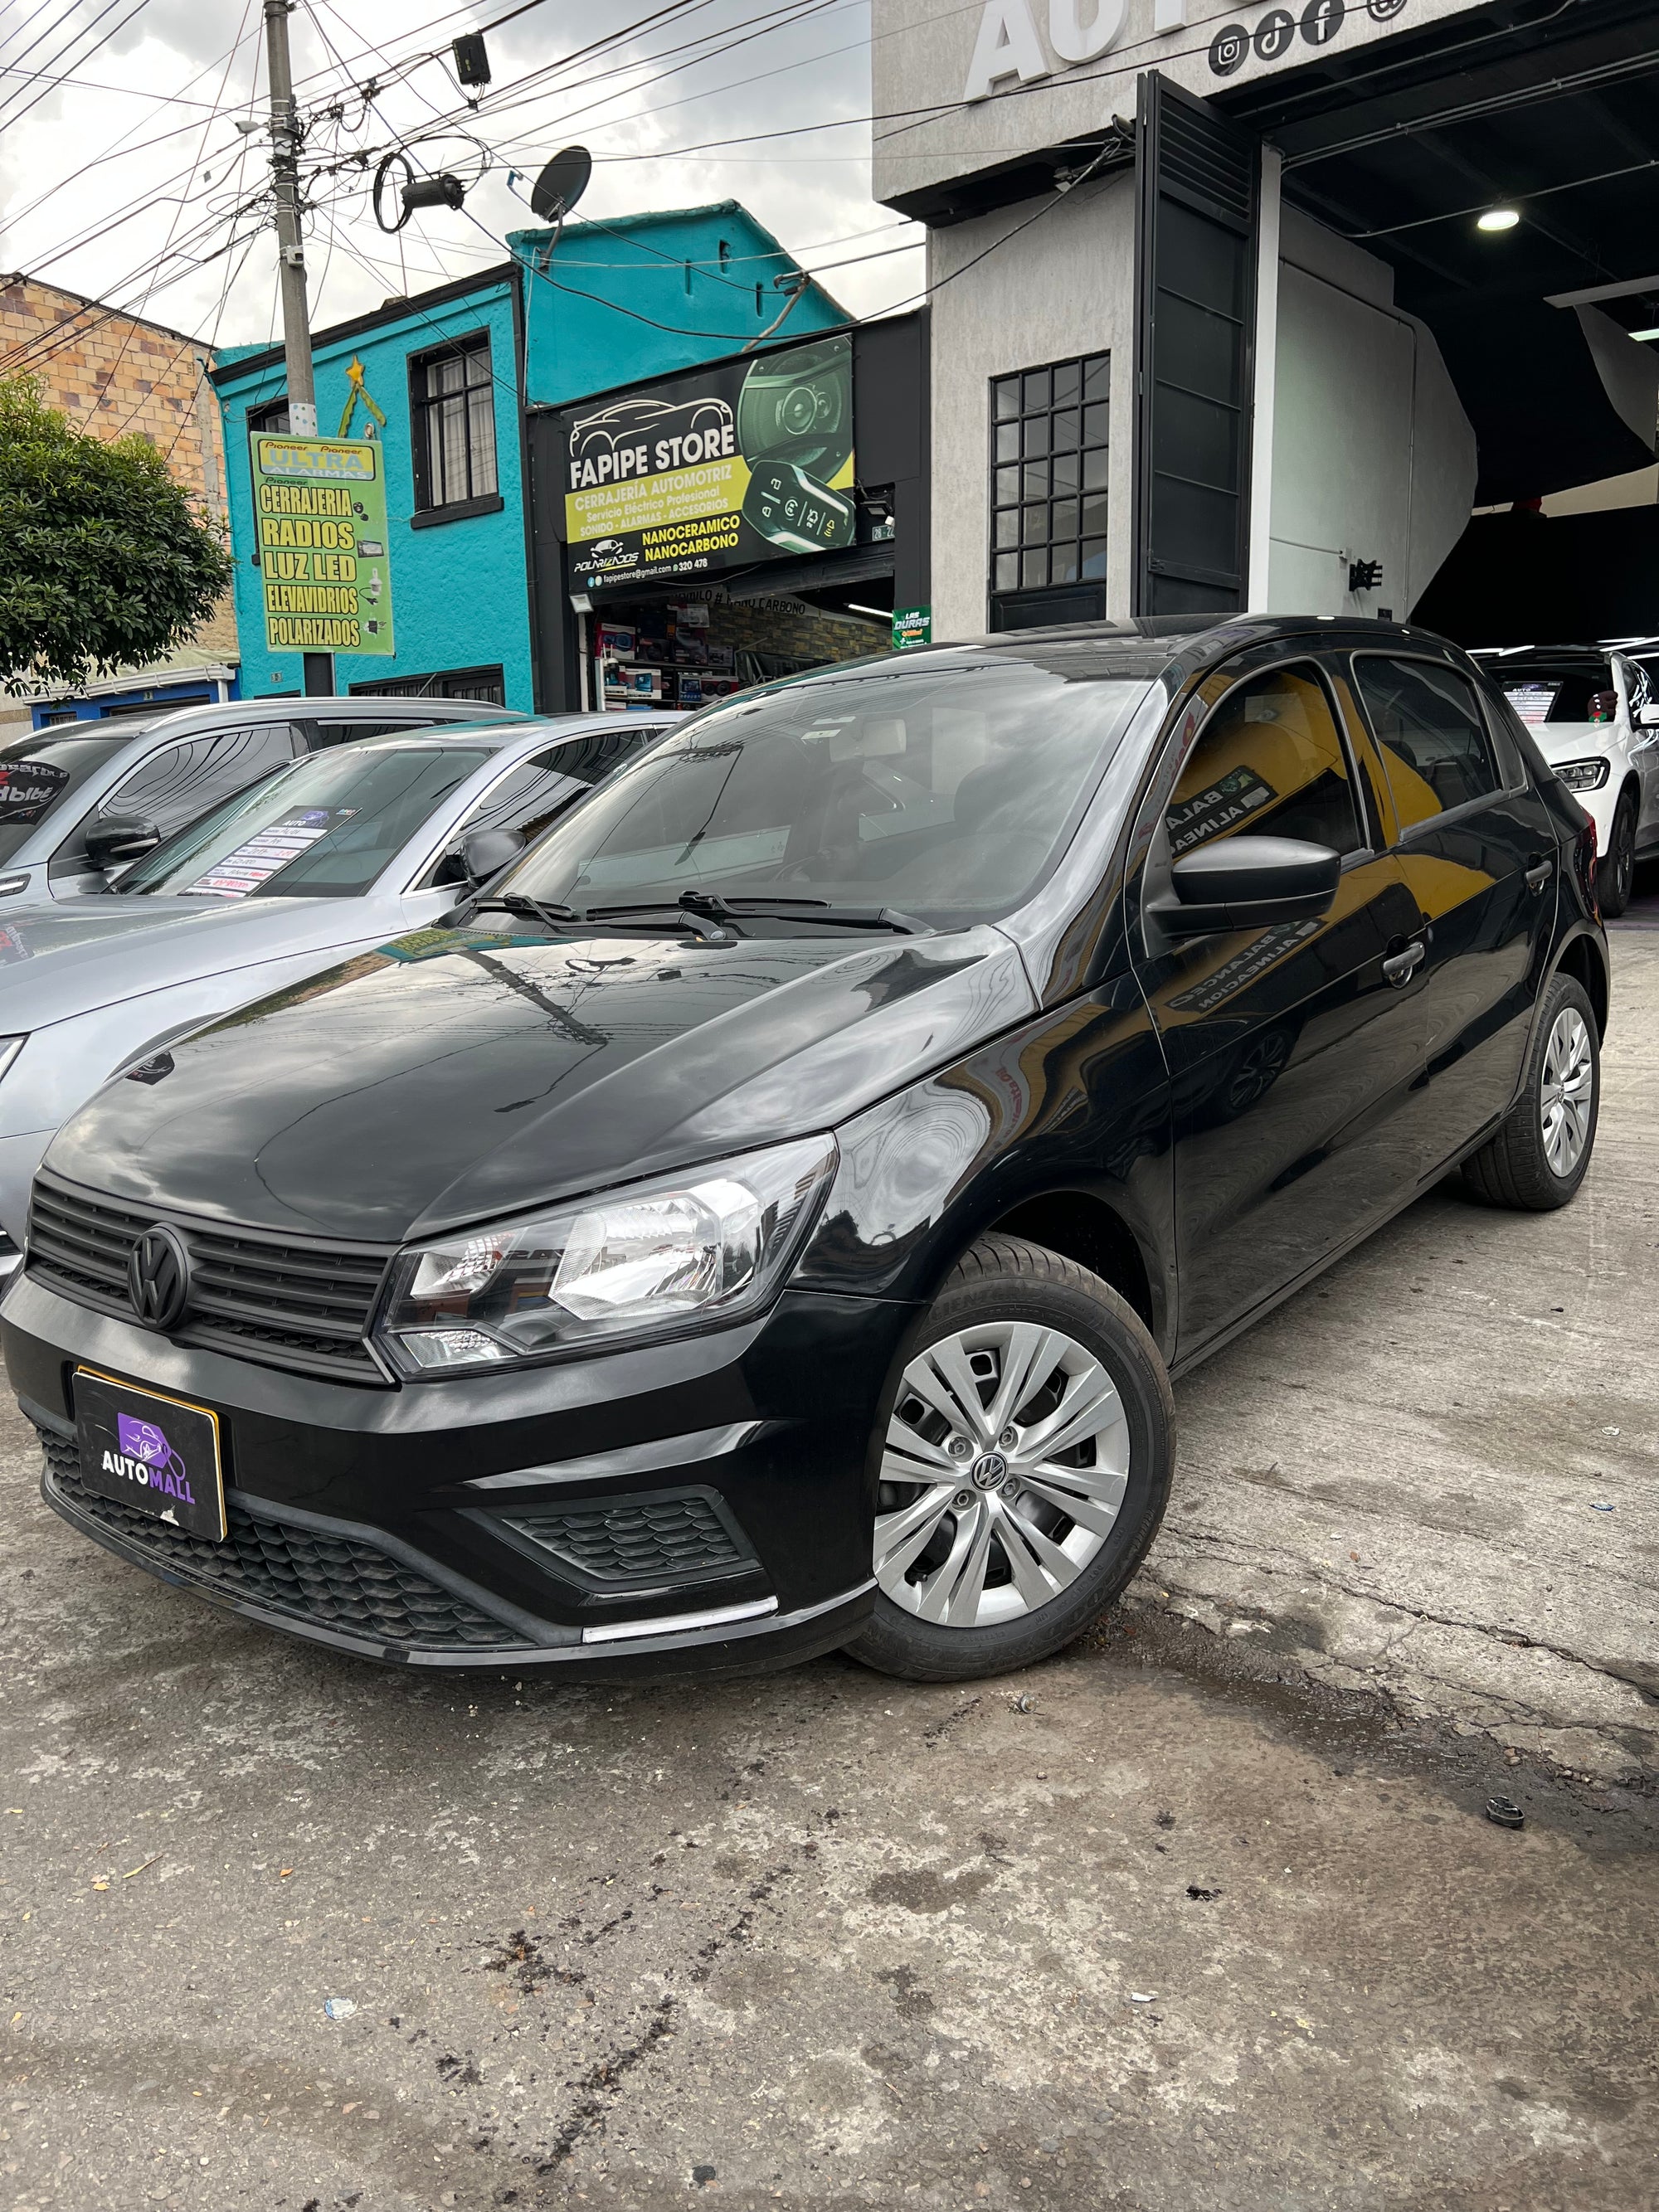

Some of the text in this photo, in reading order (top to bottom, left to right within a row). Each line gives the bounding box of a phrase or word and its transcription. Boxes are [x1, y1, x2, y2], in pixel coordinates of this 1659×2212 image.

[265, 441, 362, 455] Pioneer Pioneer
[270, 450, 364, 469] ULTRA
[570, 424, 735, 489] FAPIPE STORE
[265, 476, 307, 485] Pioneer
[270, 466, 367, 479] ALARMAS
[574, 464, 732, 512] CERRAJERÍA AUTOMOTRIZ
[260, 484, 353, 518] CERRAJERIA
[586, 485, 720, 523] Servicio Eléctrico Profesional
[580, 523, 614, 537] SONIDO
[620, 511, 662, 529] ALARMAS
[668, 498, 729, 520] ACCESORIOS
[642, 514, 741, 546] NANOCERAMICO
[261, 518, 355, 550] RADIOS
[645, 532, 739, 562] NANOCARBONO
[264, 551, 358, 582] LUZ LED
[574, 552, 640, 572] POLARIZADOS
[603, 566, 672, 584] fapipestore@gmail.com
[679, 562, 693, 571] 320
[266, 584, 359, 615] ELEVAVIDRIOS
[758, 597, 806, 615] CARBONO
[268, 616, 361, 647] POLARIZADOS
[101, 1450, 196, 1505] AUTOMALL
